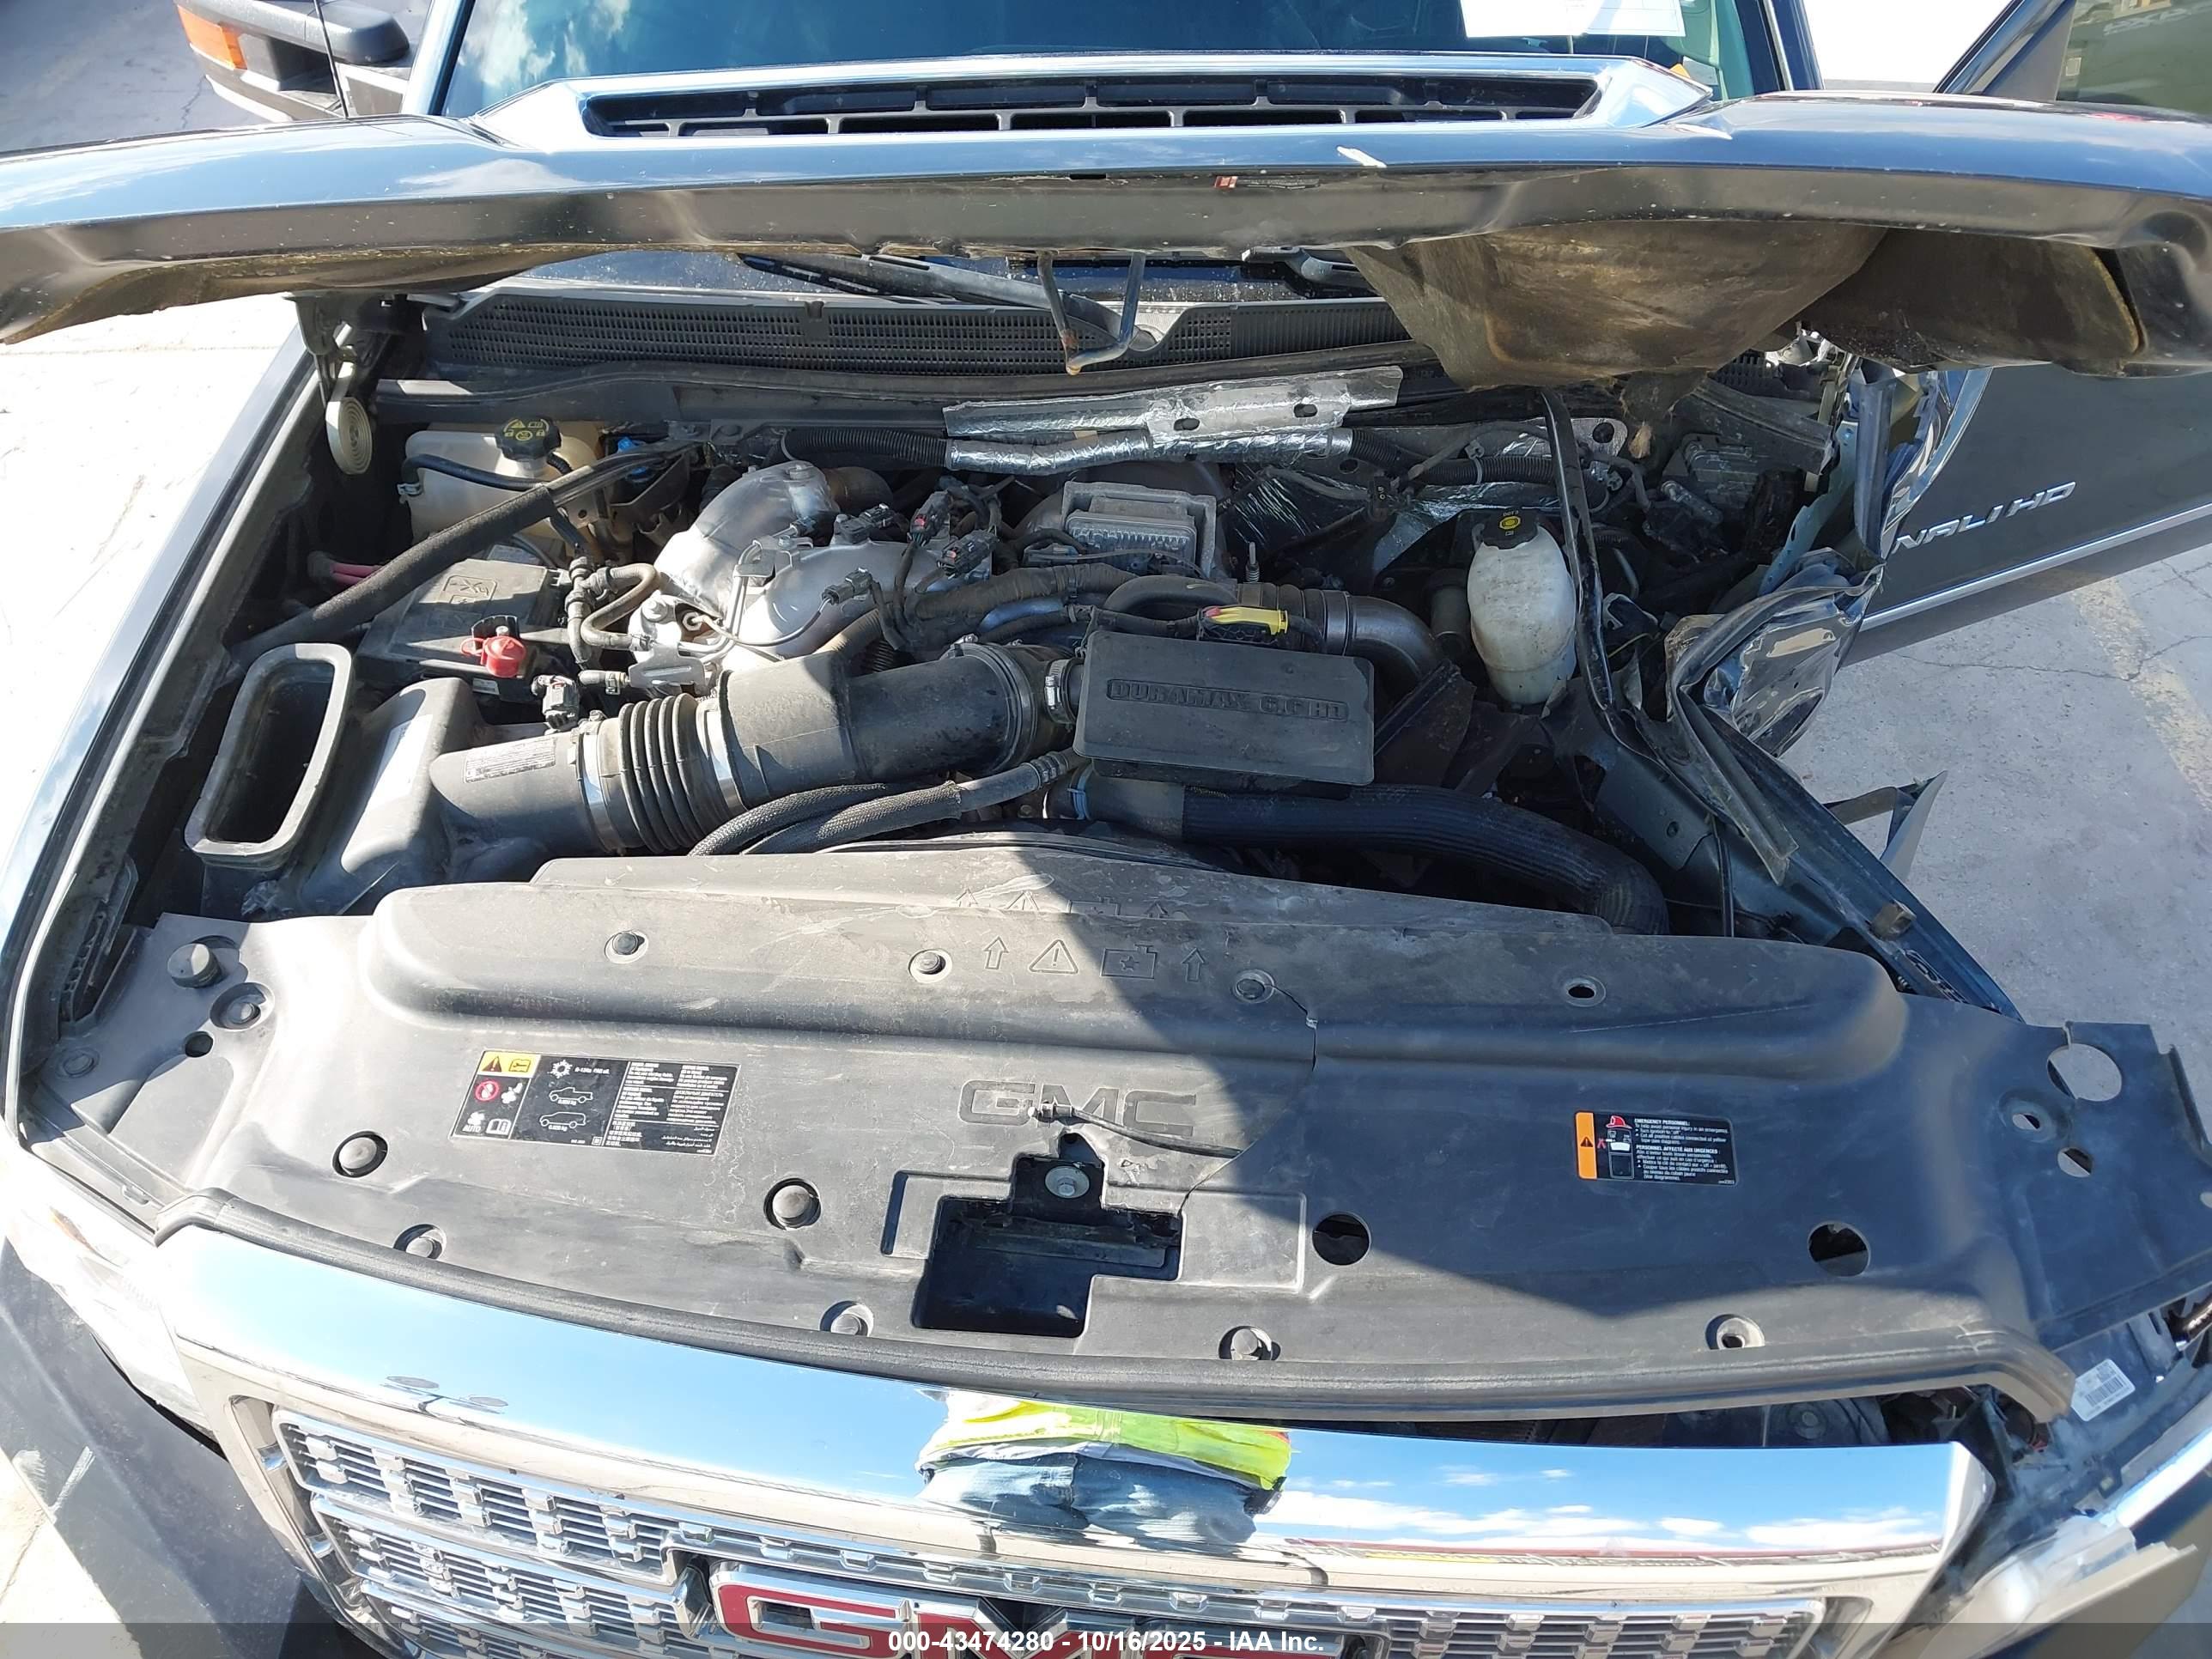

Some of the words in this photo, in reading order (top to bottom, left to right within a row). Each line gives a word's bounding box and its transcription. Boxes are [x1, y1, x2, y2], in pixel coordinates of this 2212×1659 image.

[1892, 504, 2003, 554] NALI
[2006, 481, 2076, 519] HD
[1109, 681, 1248, 710] DURAMAX
[1308, 700, 1344, 720] HD
[462, 1124, 481, 1133] AUTO
[957, 1079, 1197, 1138] GMC
